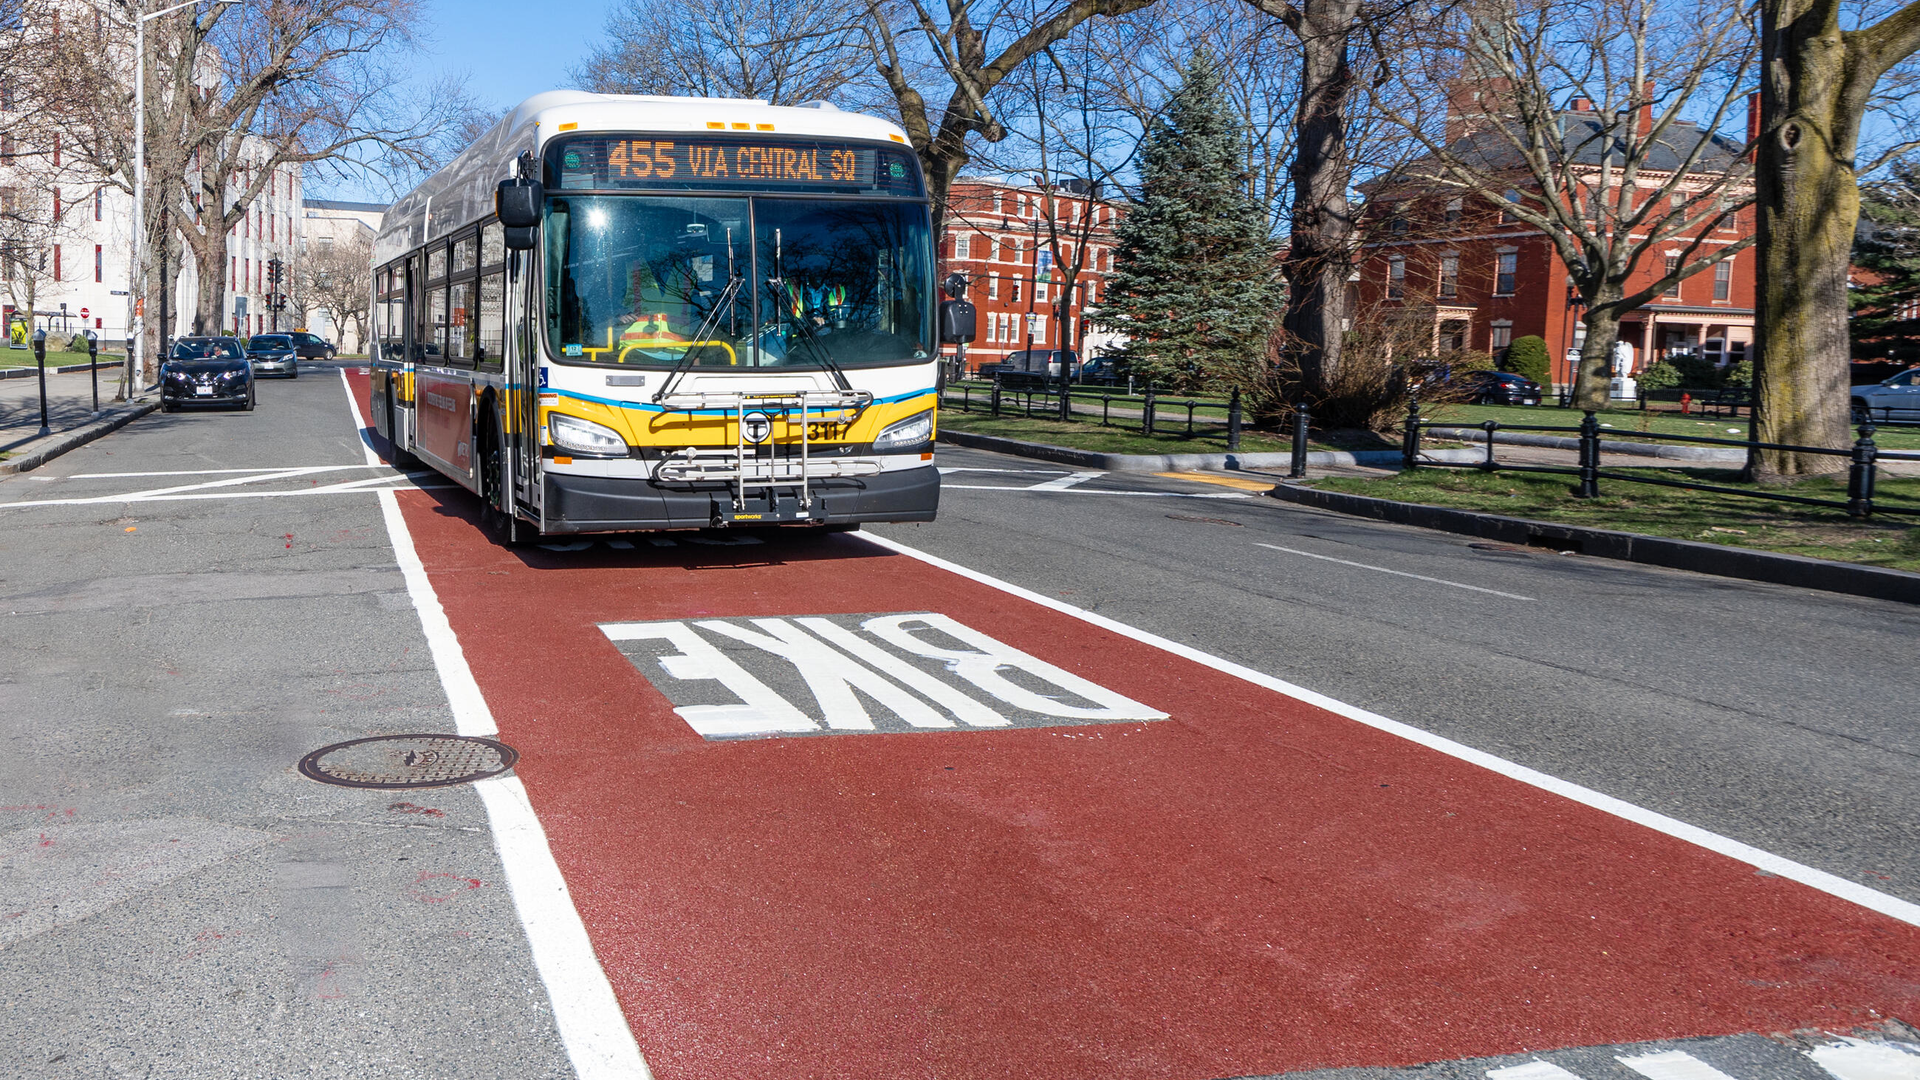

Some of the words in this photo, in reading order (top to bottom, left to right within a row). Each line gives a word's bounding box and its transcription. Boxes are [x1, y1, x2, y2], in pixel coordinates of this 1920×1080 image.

[608, 140, 676, 178] 455
[688, 145, 729, 177] VIA
[736, 147, 823, 180] CENTRAL
[830, 149, 856, 181] SQ
[806, 421, 852, 441] 3117
[597, 612, 1171, 735] BIKE
